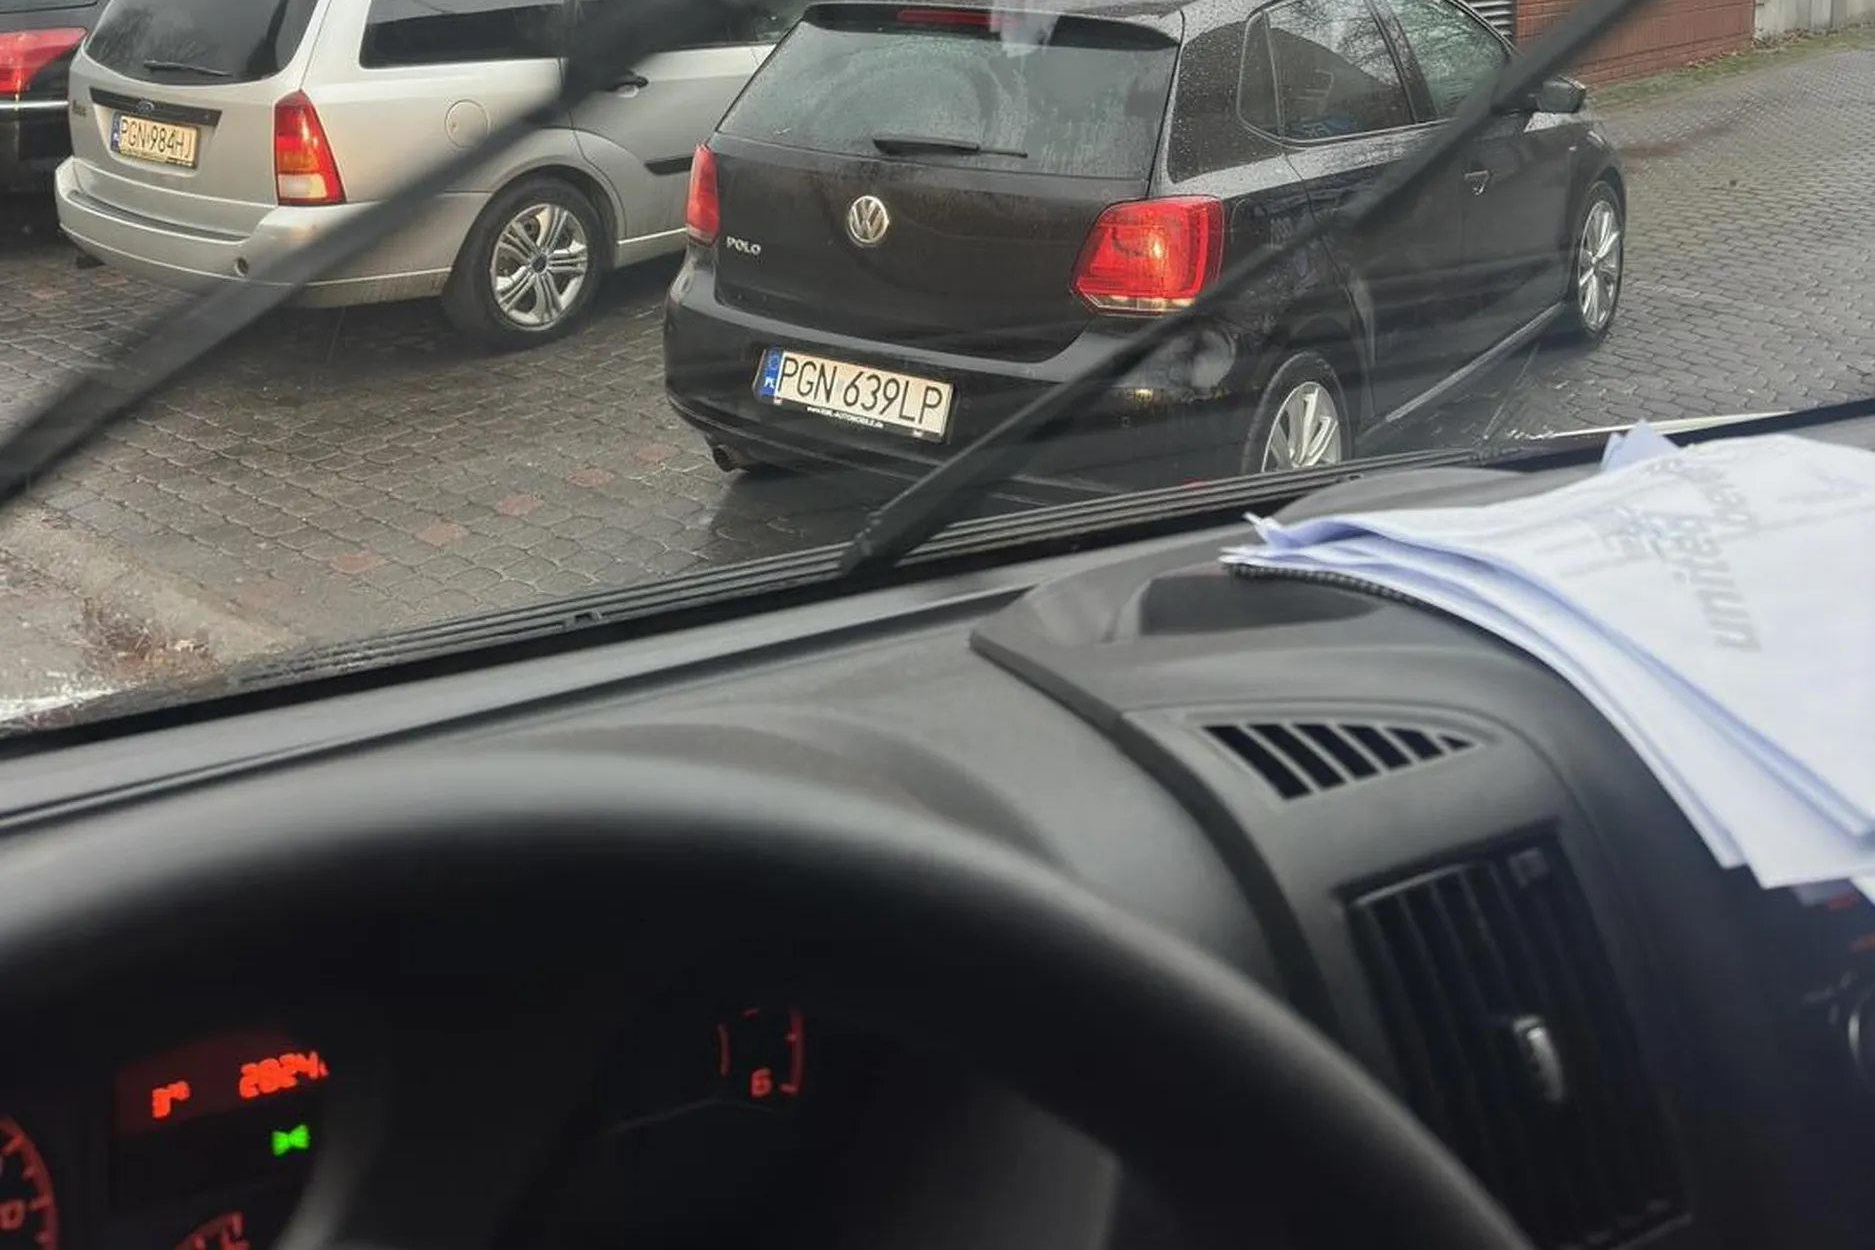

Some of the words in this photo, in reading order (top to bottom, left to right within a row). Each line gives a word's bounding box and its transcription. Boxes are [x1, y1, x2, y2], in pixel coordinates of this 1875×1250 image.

[120, 118, 148, 148] PGN
[726, 235, 762, 256] POLO
[777, 356, 838, 404] PGN
[842, 370, 943, 424] 639LP
